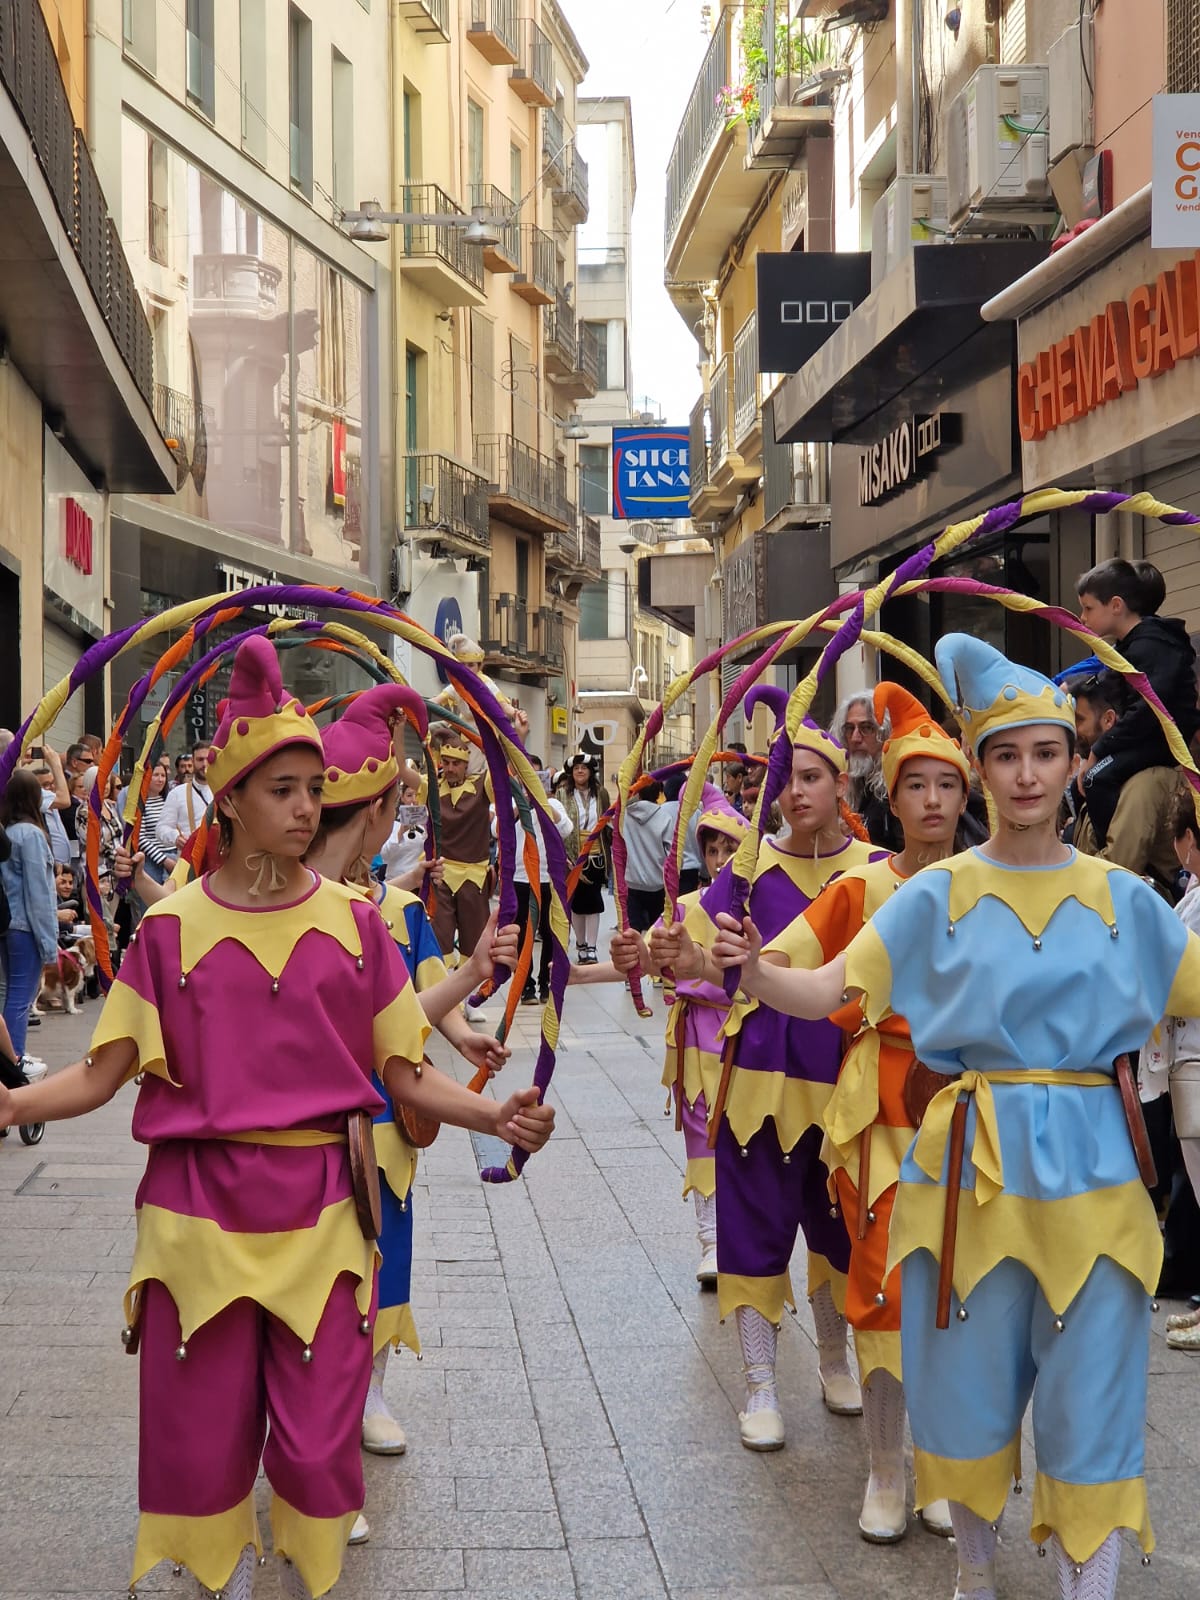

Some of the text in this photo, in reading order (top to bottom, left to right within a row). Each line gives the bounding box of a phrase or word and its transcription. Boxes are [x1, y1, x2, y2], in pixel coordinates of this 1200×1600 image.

[1176, 130, 1200, 139] Ven
[1018, 250, 1200, 441] CHEMA GAL
[624, 469, 690, 487] TANA
[858, 421, 910, 507] MISAKO
